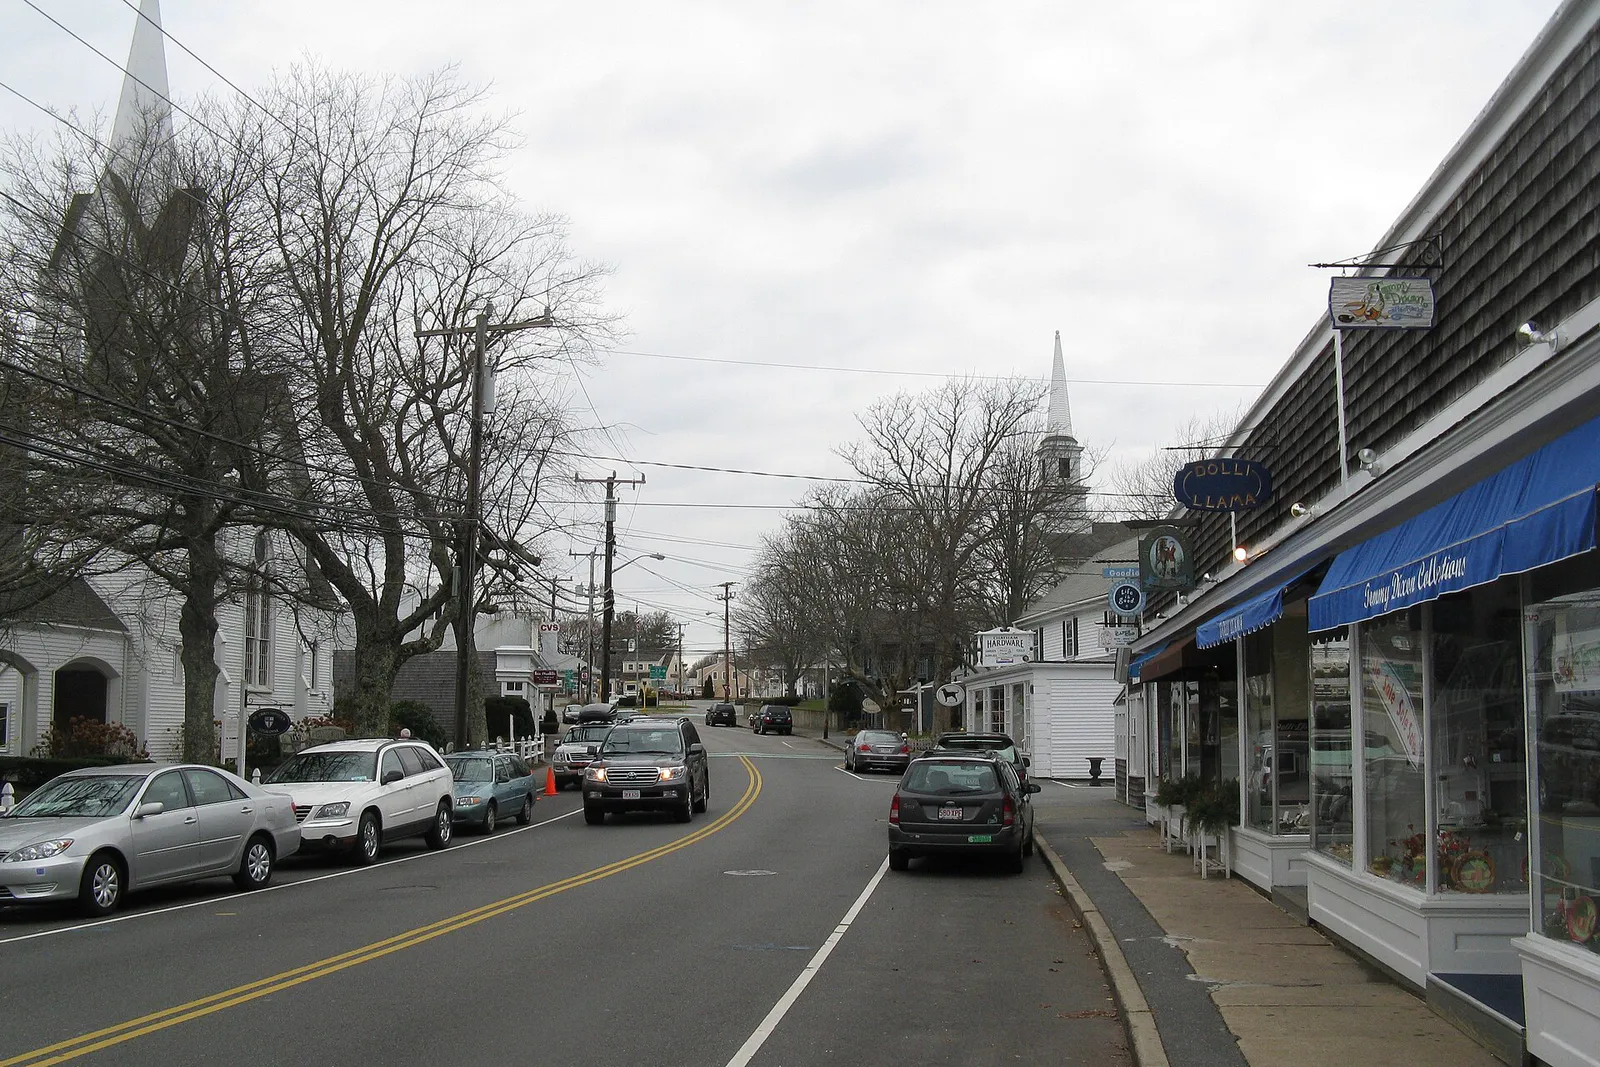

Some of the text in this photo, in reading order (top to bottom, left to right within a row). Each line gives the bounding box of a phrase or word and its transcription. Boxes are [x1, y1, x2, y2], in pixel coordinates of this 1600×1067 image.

[1195, 462, 1250, 477] DOLLI
[1193, 494, 1256, 508] LLAMA
[987, 639, 1024, 648] HARDWARE
